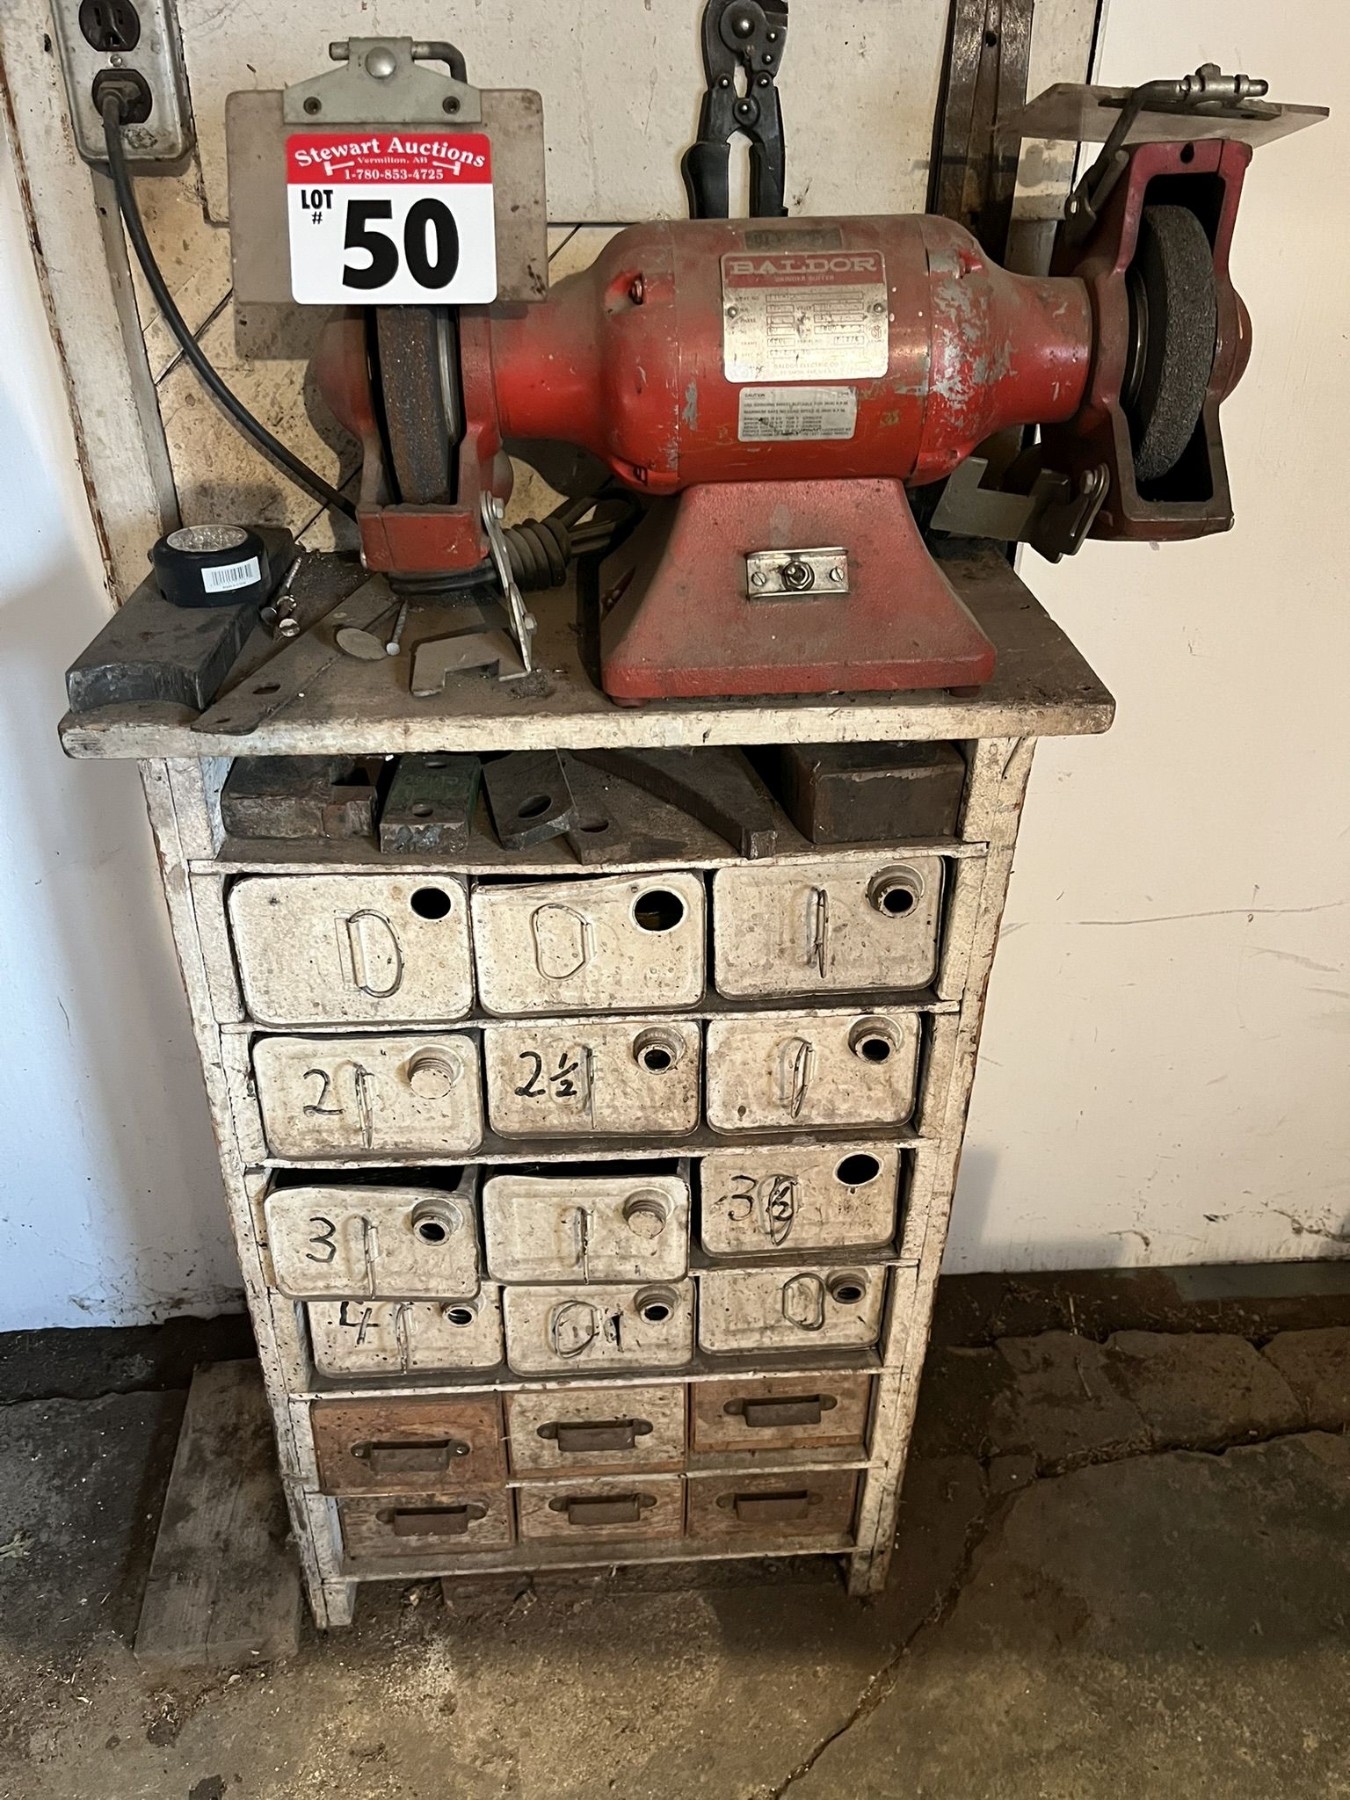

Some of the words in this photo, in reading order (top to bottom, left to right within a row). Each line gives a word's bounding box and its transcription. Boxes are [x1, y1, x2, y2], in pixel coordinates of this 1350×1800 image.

[294, 138, 381, 167] Stewart
[387, 137, 486, 168] Auctions
[413, 156, 428, 164] AB
[344, 169, 444, 180] 1-780-853-4725
[300, 189, 334, 210] LOT
[311, 211, 323, 225] #
[342, 197, 460, 290] 50
[729, 257, 877, 275] BALDOR
[303, 1068, 346, 1117] 2
[306, 1216, 336, 1263] 3
